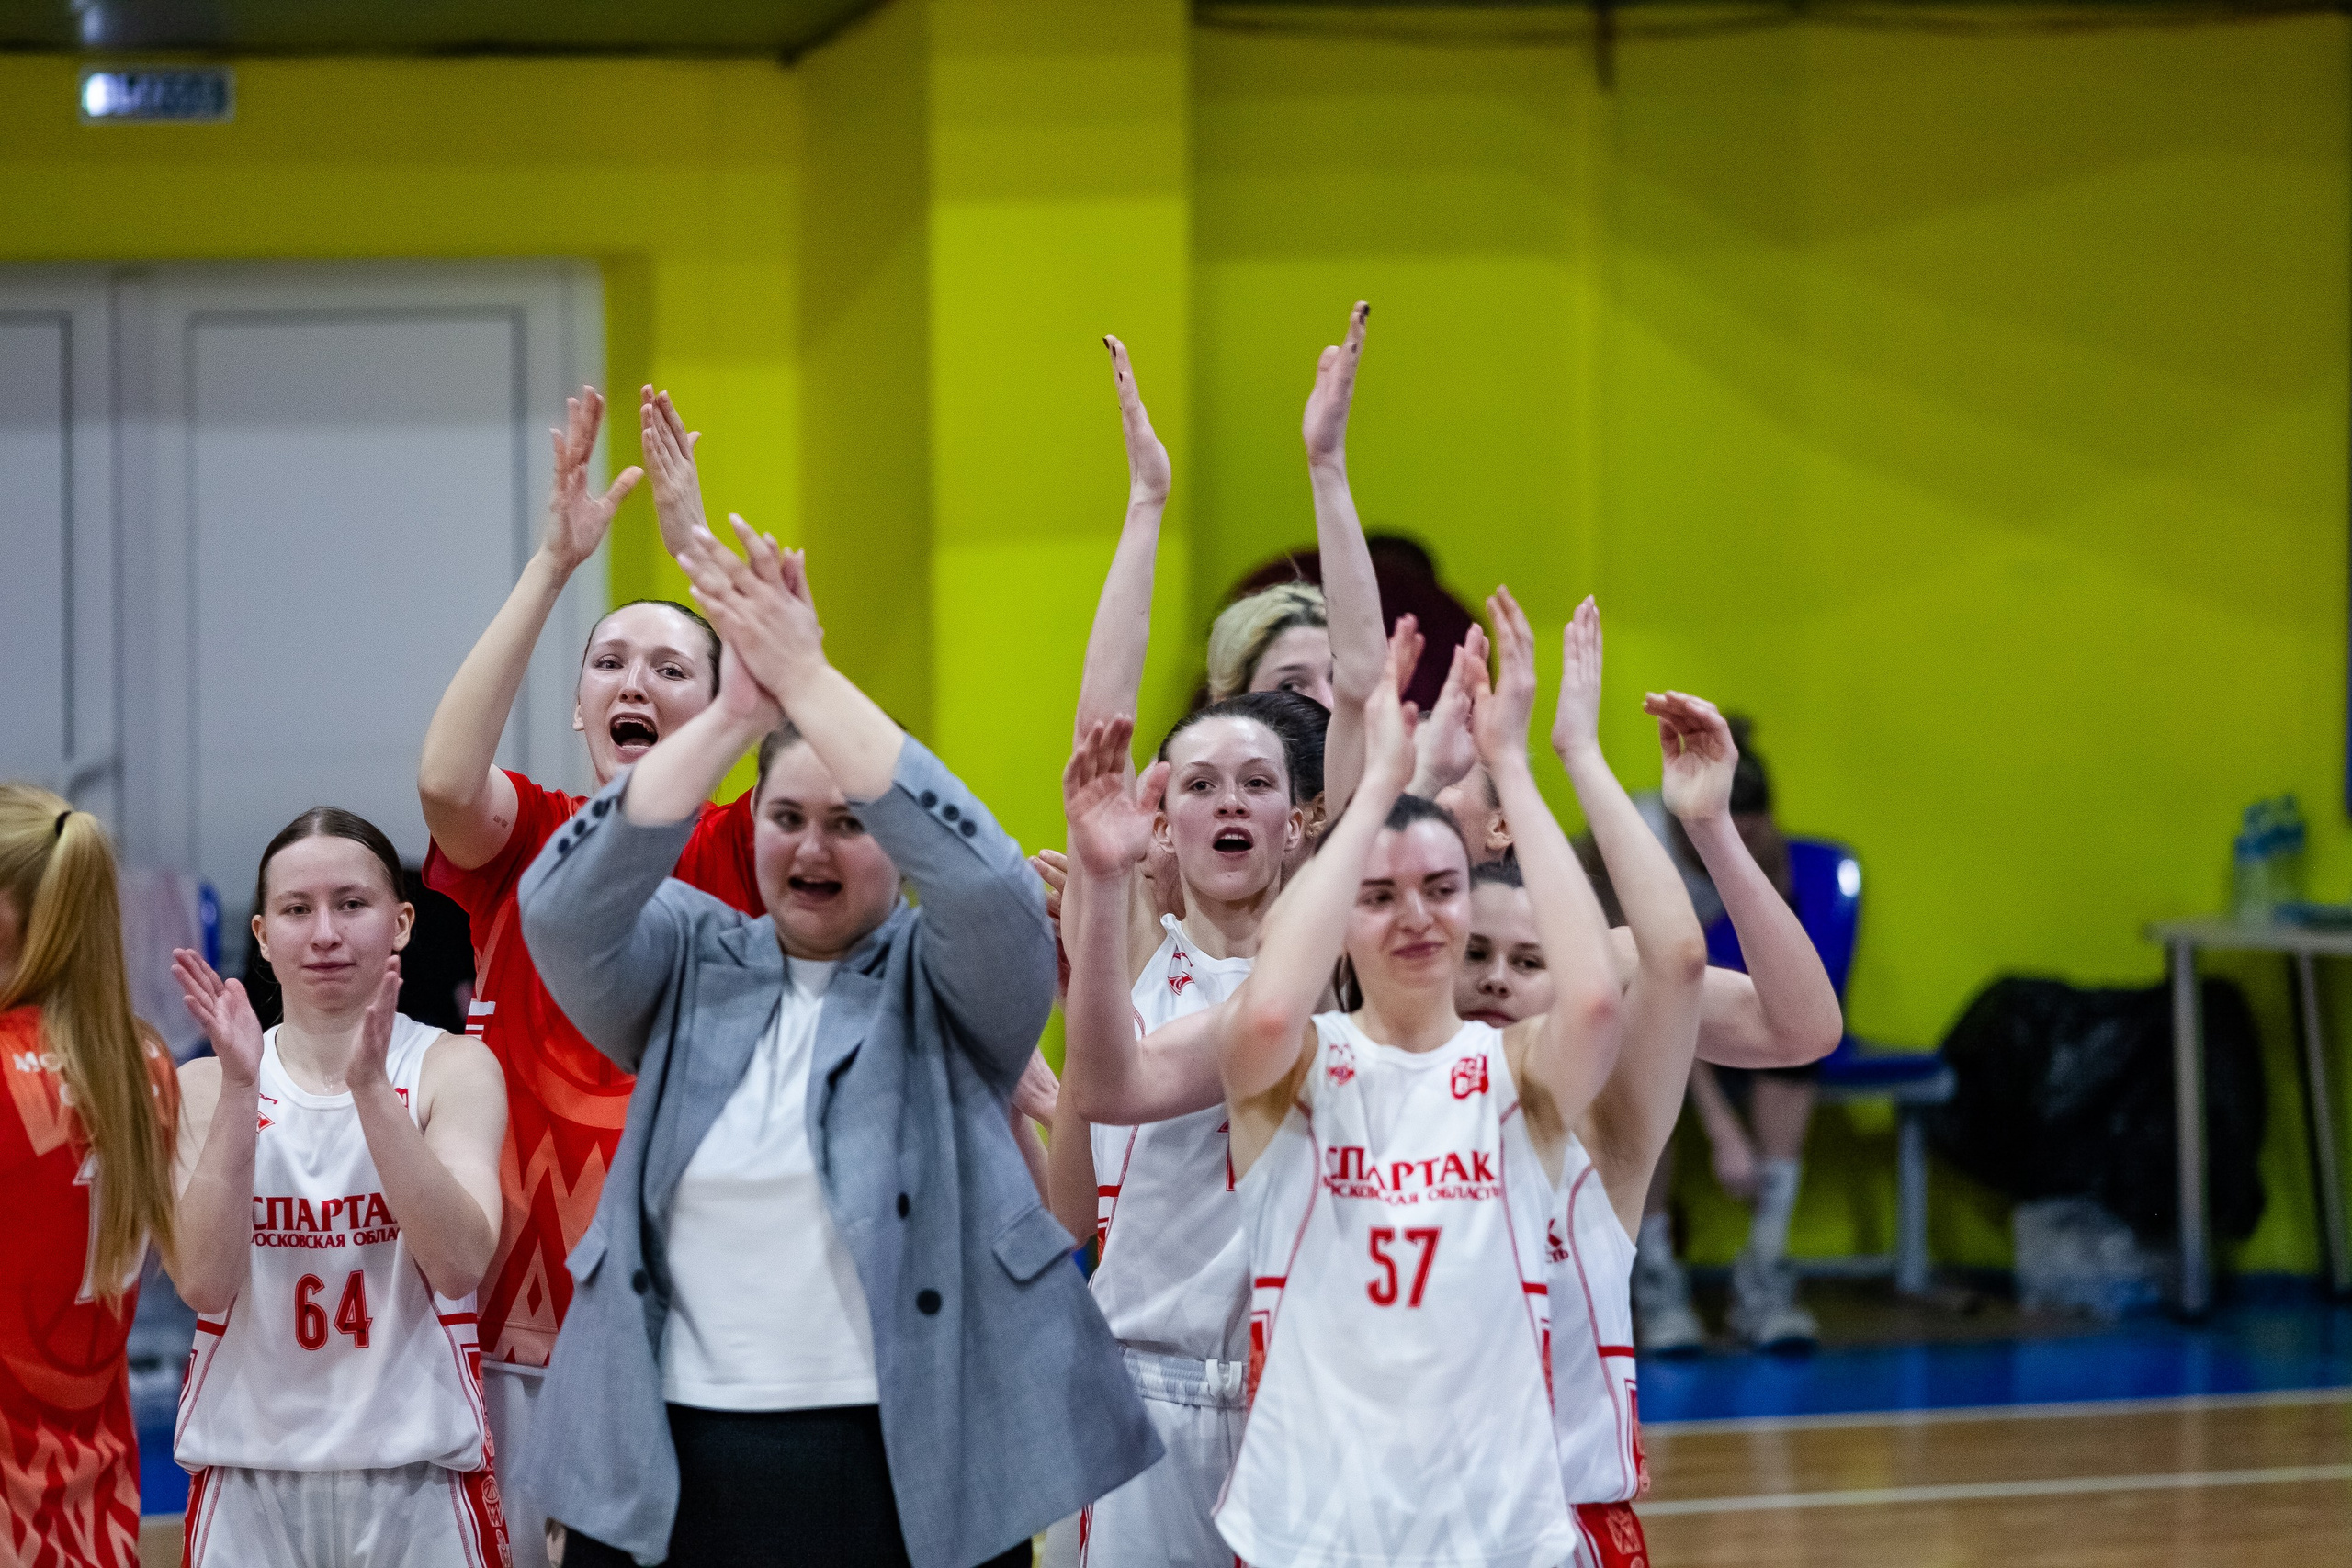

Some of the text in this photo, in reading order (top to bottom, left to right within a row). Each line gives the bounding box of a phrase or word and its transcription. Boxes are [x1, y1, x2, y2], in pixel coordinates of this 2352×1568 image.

[1325, 1145, 1495, 1191] СПАРТАК
[253, 1192, 398, 1233] СПАРТА
[251, 1227, 401, 1249] ОСКОВСКАЯ ОБЛА
[1365, 1225, 1442, 1309] 57
[294, 1269, 373, 1351] 64
